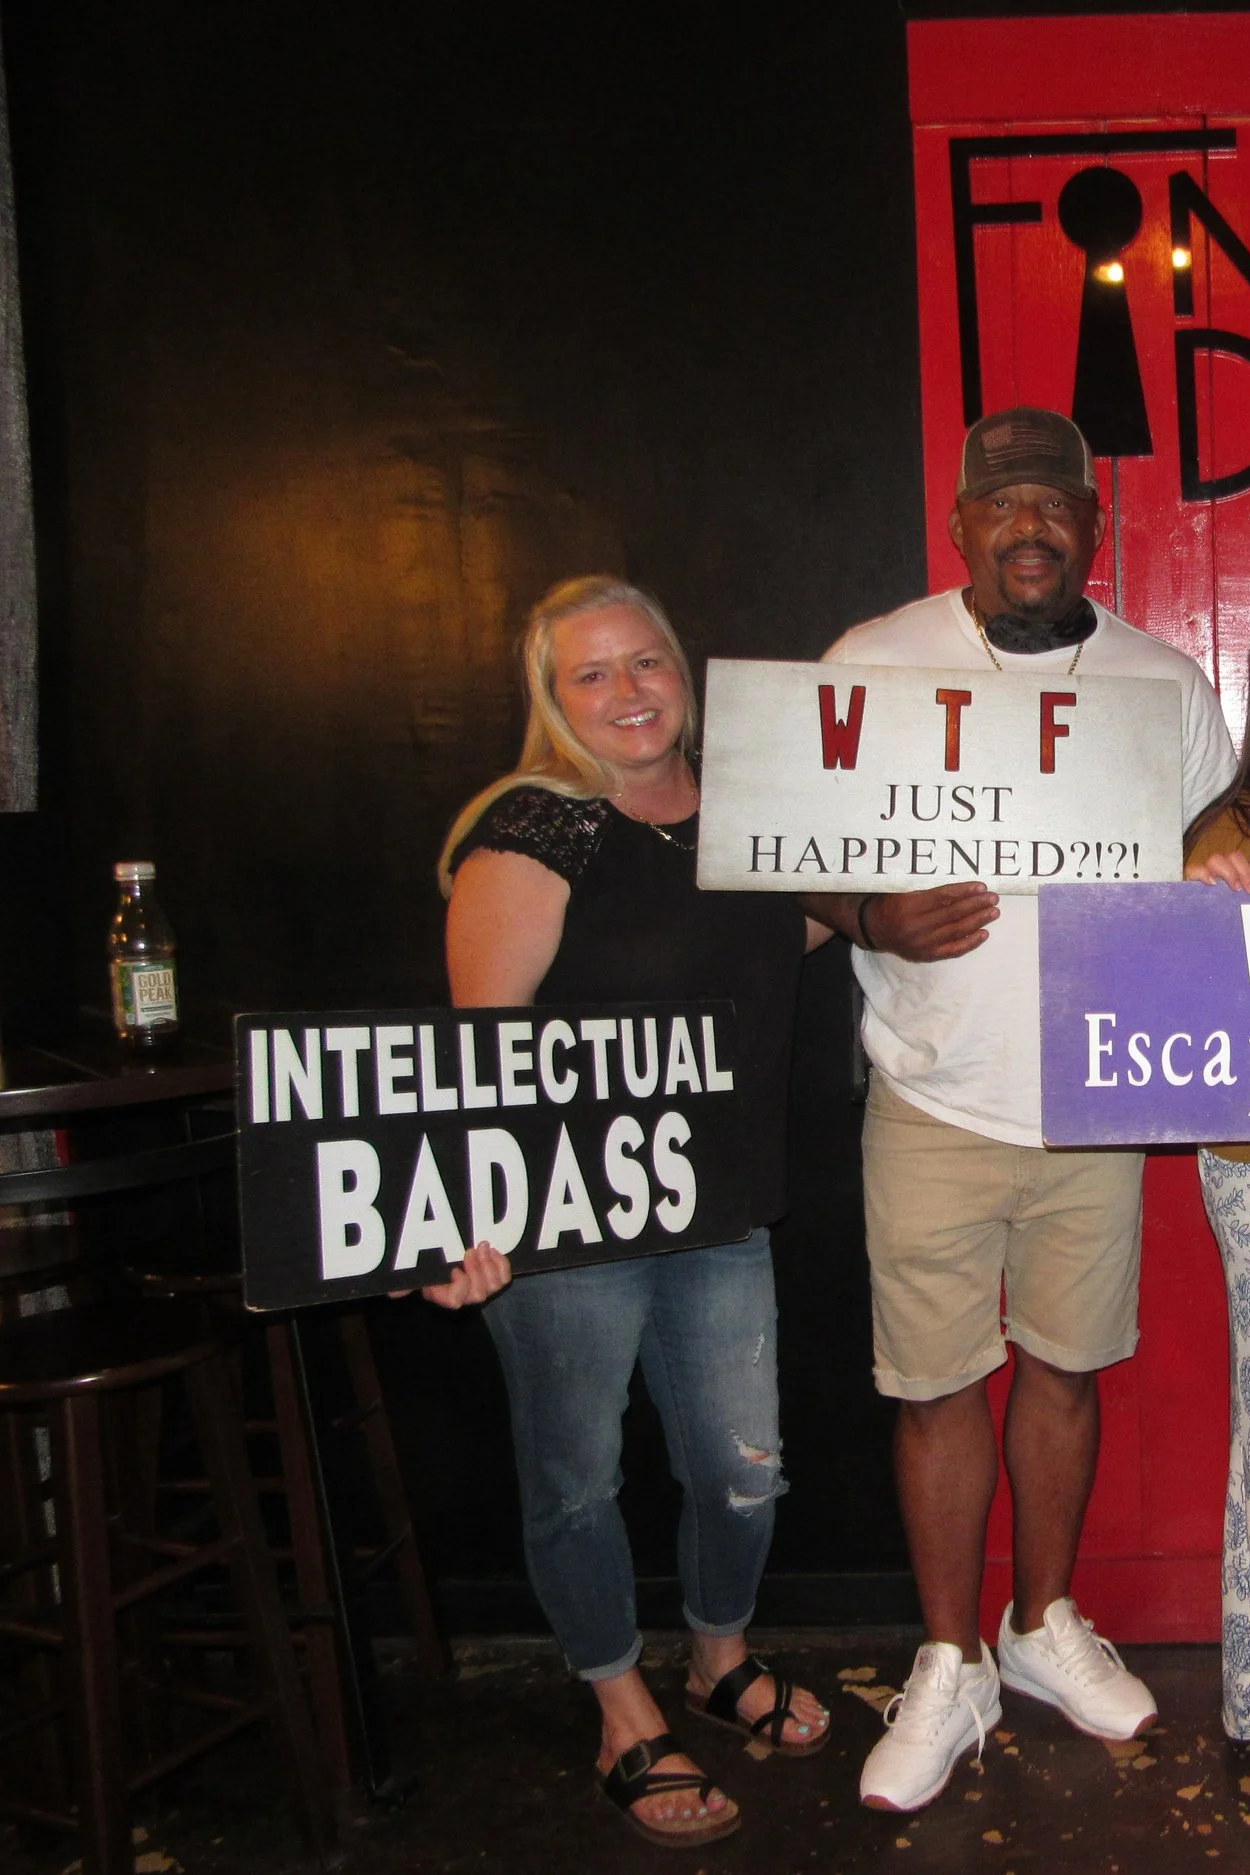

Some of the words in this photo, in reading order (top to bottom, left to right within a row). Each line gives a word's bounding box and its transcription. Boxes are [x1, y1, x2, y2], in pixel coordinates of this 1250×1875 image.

[880, 784, 1013, 823] JUST
[748, 835, 1140, 879] HAPPENED?!?!
[139, 971, 172, 987] GOLD
[139, 986, 173, 1002] PEAK
[250, 1015, 734, 1124] INTELLECTUAL
[316, 1111, 697, 1281] BADASS
